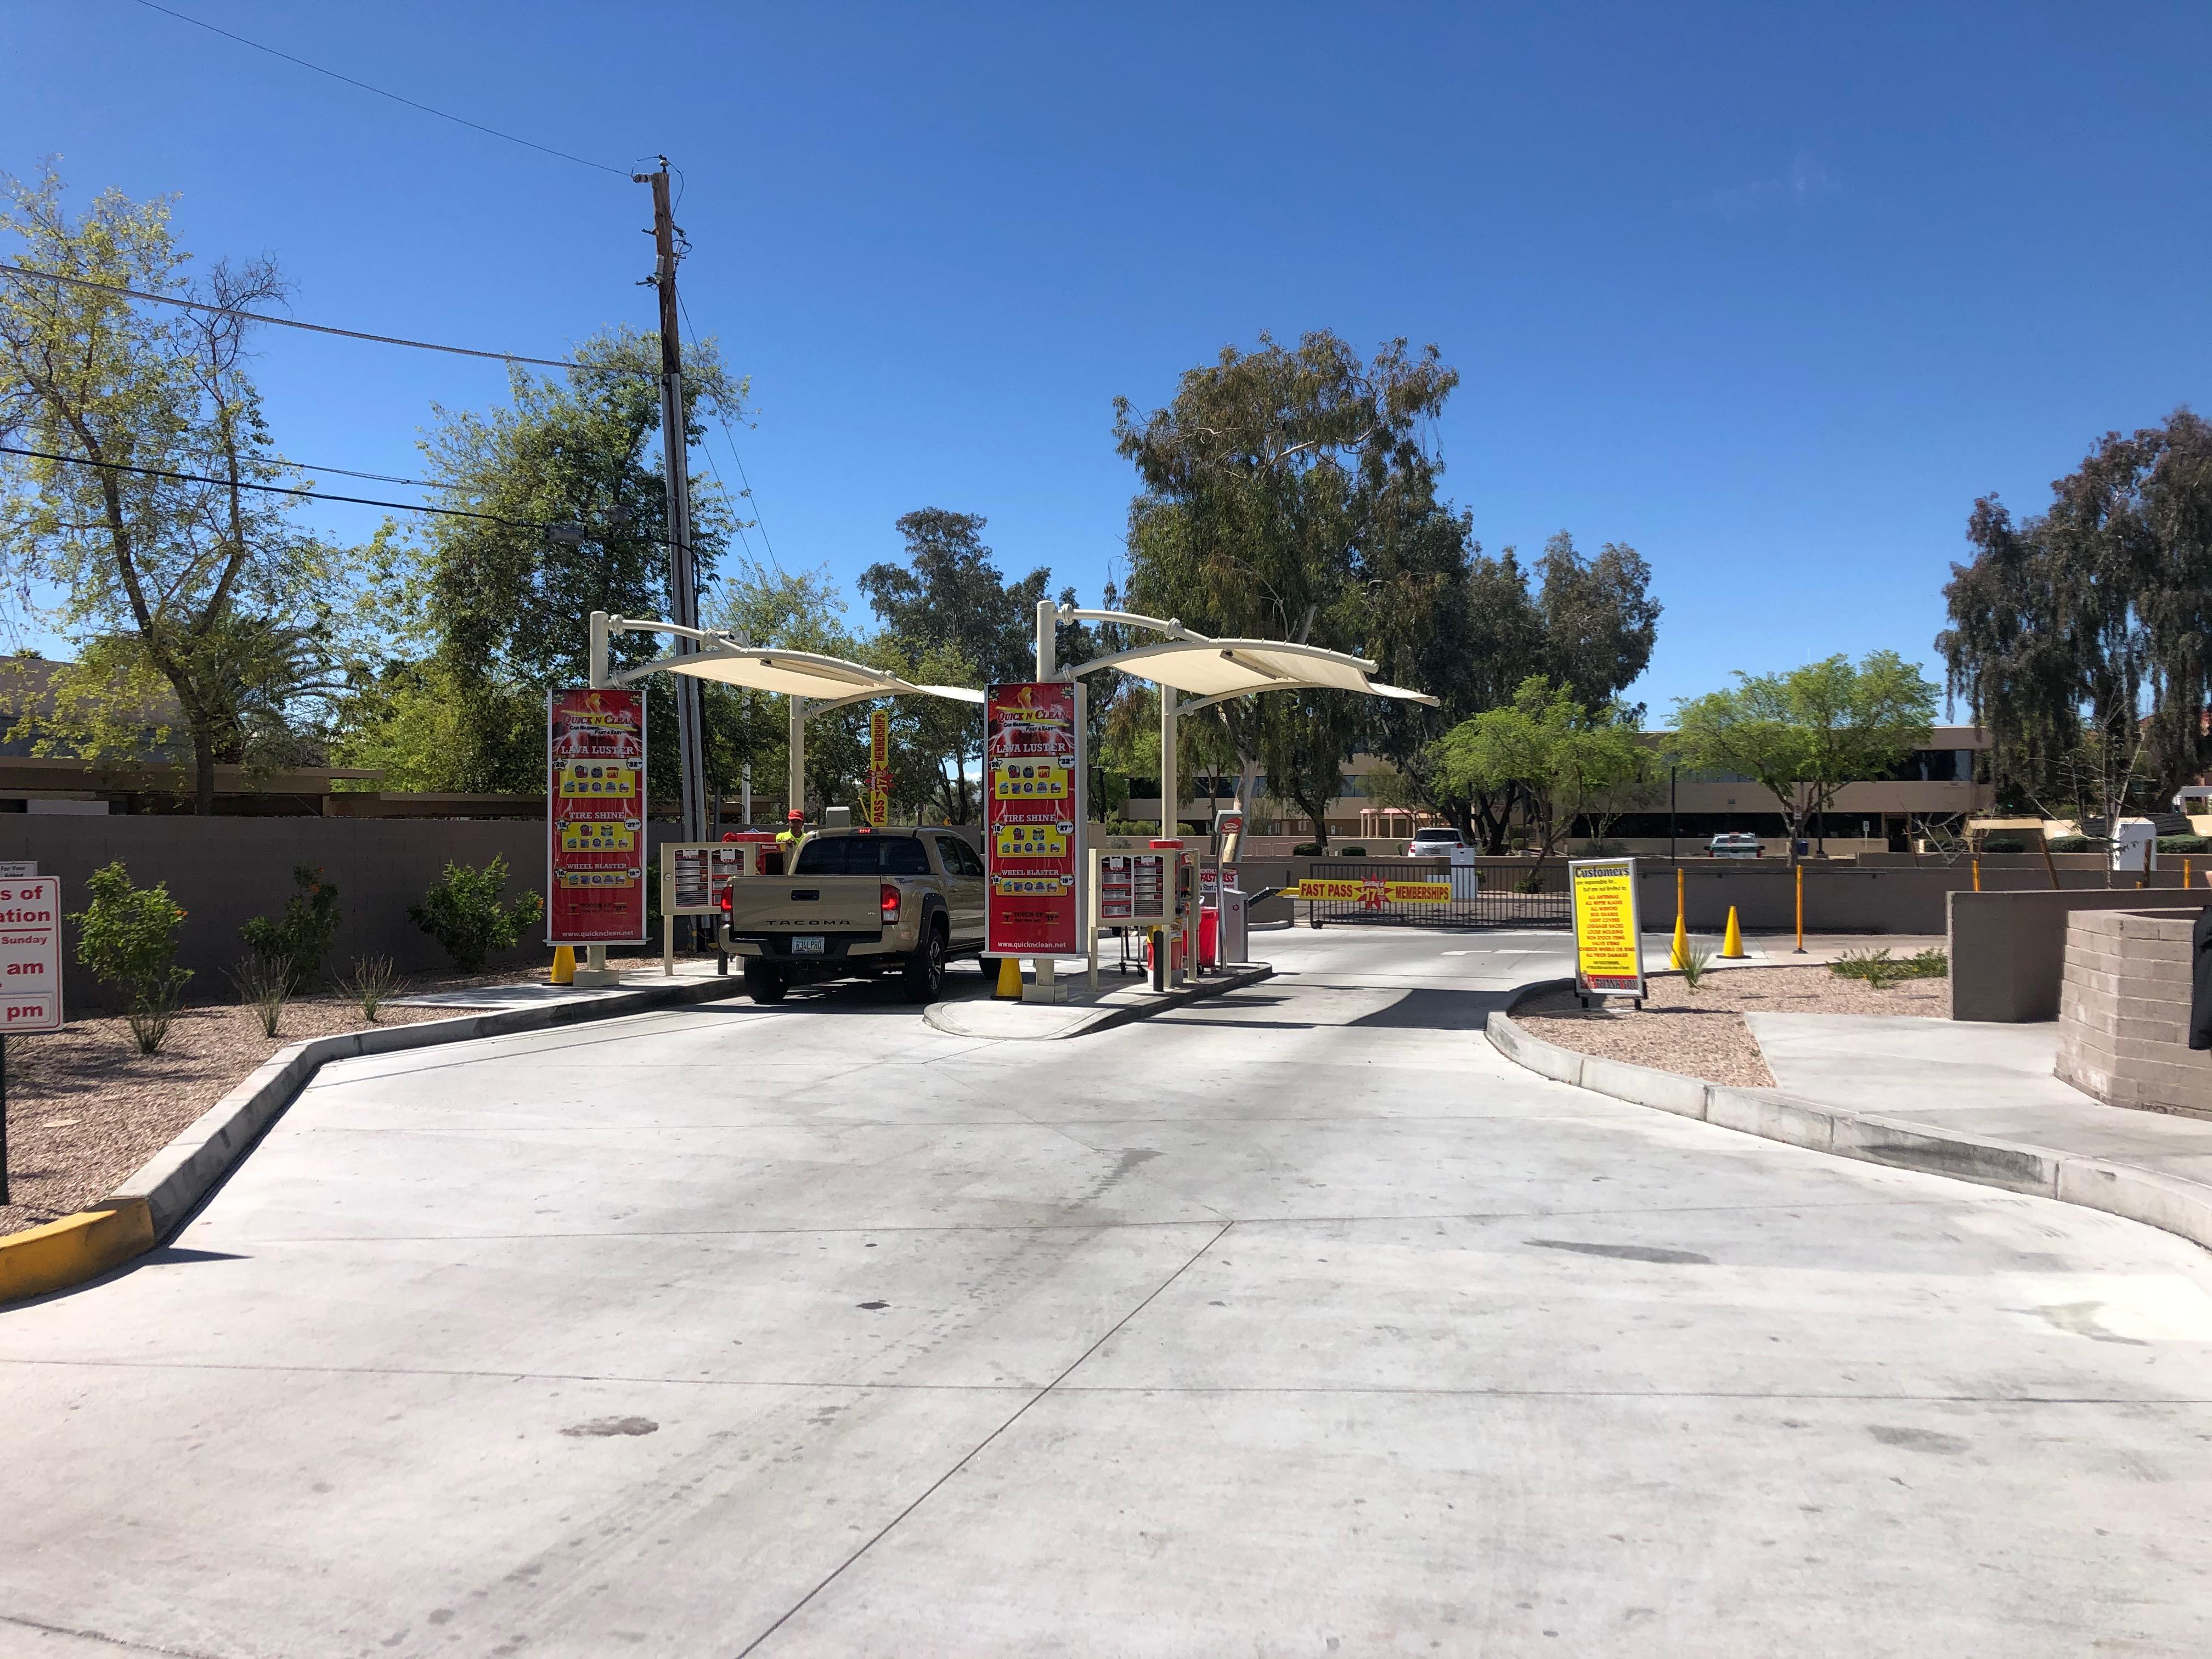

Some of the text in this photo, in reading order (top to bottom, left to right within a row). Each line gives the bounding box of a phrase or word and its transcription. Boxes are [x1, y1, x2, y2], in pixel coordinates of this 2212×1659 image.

[563, 715, 592, 727] QUICK
[604, 715, 635, 724] CLEAN
[998, 711, 1024, 723] QUICK
[1035, 710, 1067, 719] CLEAN
[874, 714, 885, 761] MEMBERSHIPS
[561, 746, 634, 754] LAVA LUSTER
[996, 743, 1066, 753] LAVA LUSTER
[874, 799, 885, 823] PASS
[1575, 867, 1630, 878] Customers
[21, 885, 43, 900] of
[1301, 883, 1353, 897] FAST PASS
[1395, 886, 1449, 900] MEMBERSHIPS
[2, 935, 48, 945] Sunday
[7, 962, 44, 975] am
[7, 1005, 43, 1022] pm
